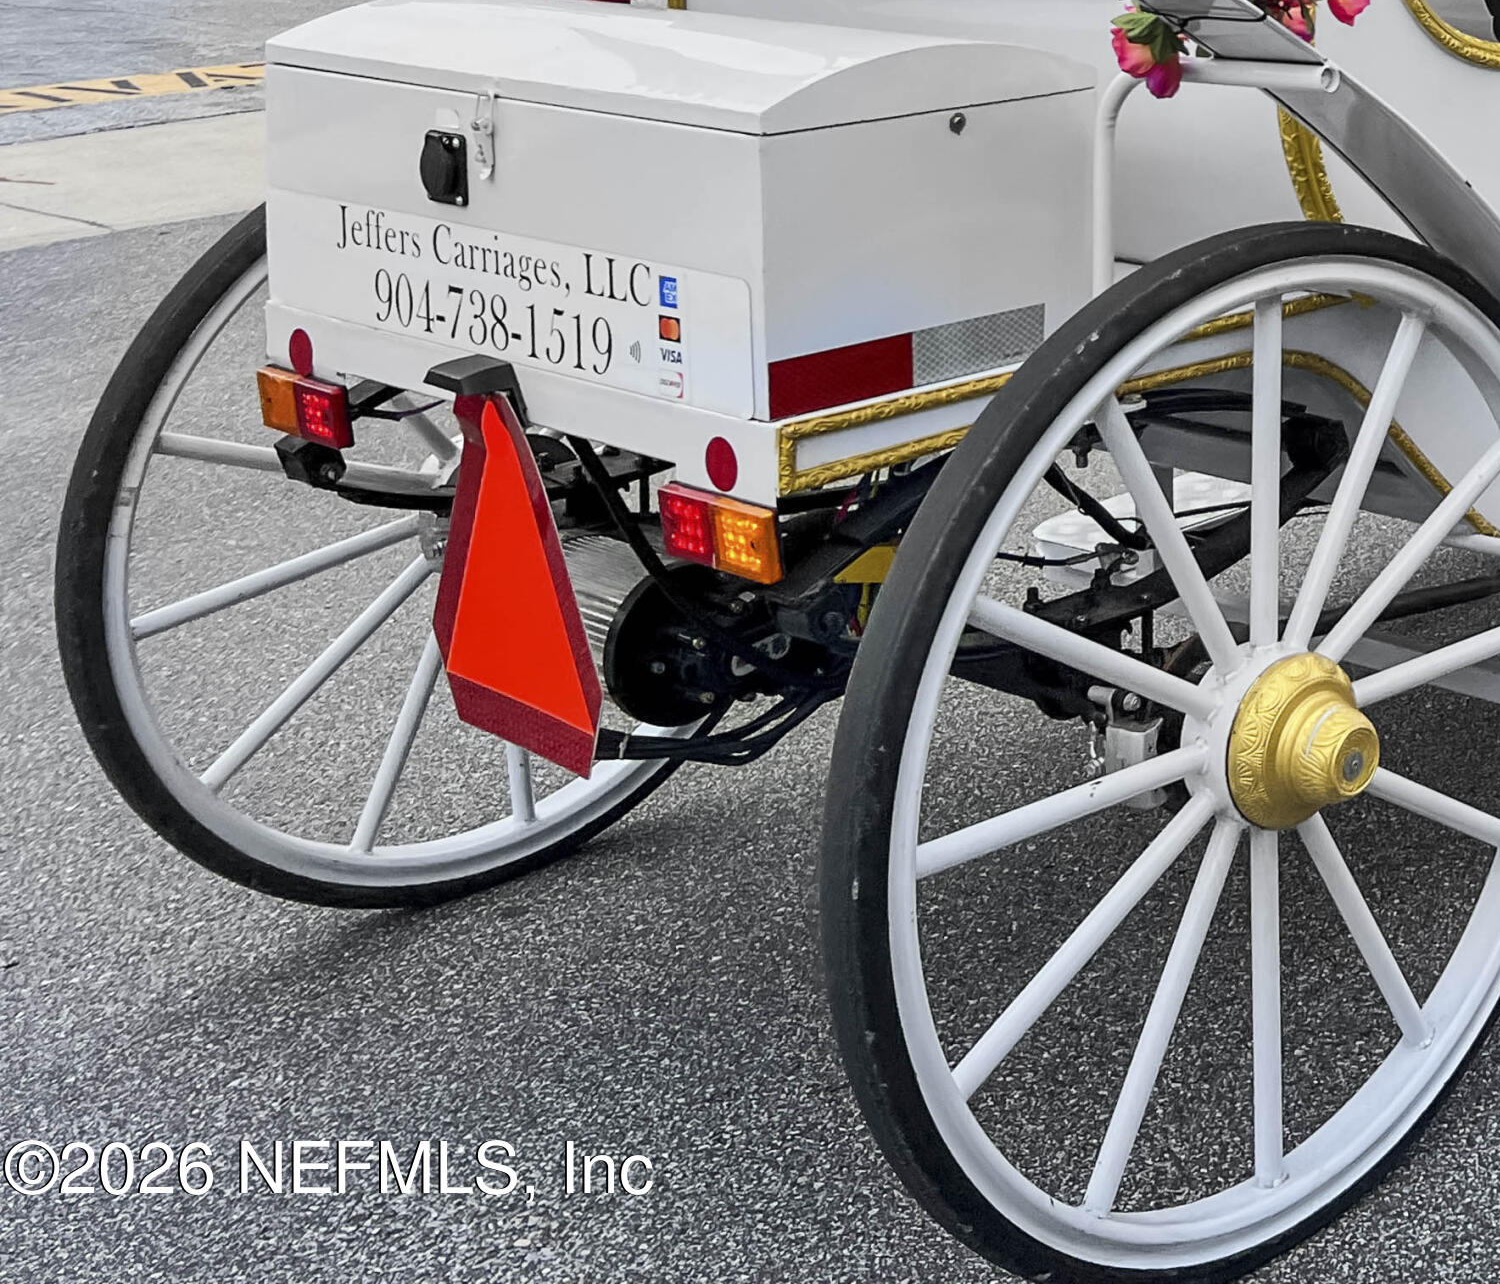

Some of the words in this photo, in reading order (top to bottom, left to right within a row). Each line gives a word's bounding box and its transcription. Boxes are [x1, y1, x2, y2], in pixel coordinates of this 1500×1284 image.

[336, 204, 421, 258] Jeffers
[432, 223, 571, 296] Carriages,
[582, 252, 652, 307] LLC
[374, 268, 613, 375] 904-738-1519
[660, 348, 683, 364] VISA
